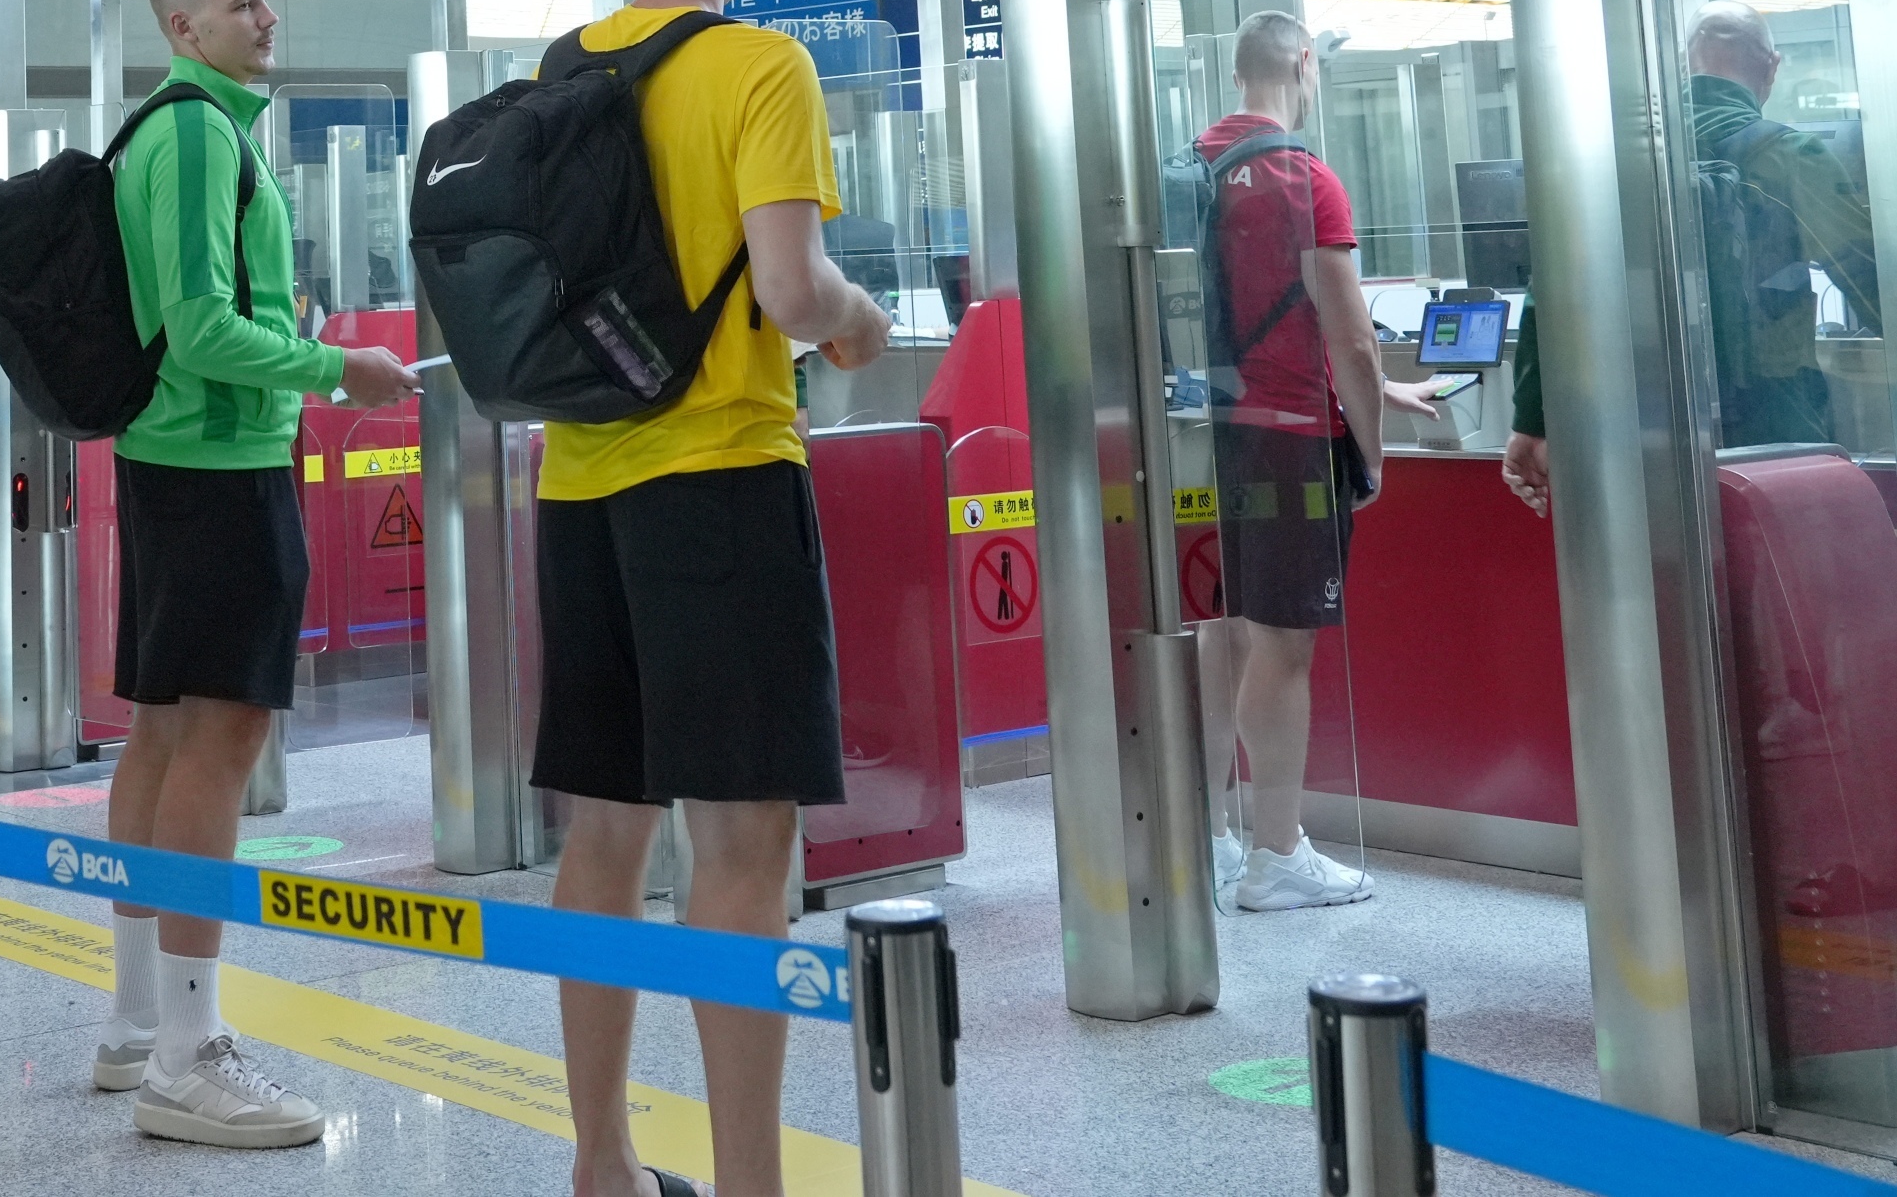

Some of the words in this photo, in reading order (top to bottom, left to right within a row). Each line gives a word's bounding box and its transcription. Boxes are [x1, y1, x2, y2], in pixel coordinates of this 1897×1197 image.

[761, 7, 866, 43] のお客様
[981, 5, 998, 18] Exit
[81, 852, 130, 887] BCIA
[270, 880, 465, 946] SECURITY
[320, 1036, 381, 1056] Please
[377, 1055, 434, 1074] queue
[431, 1070, 502, 1094] behind
[493, 1087, 528, 1103] the
[519, 1100, 574, 1120] yello
